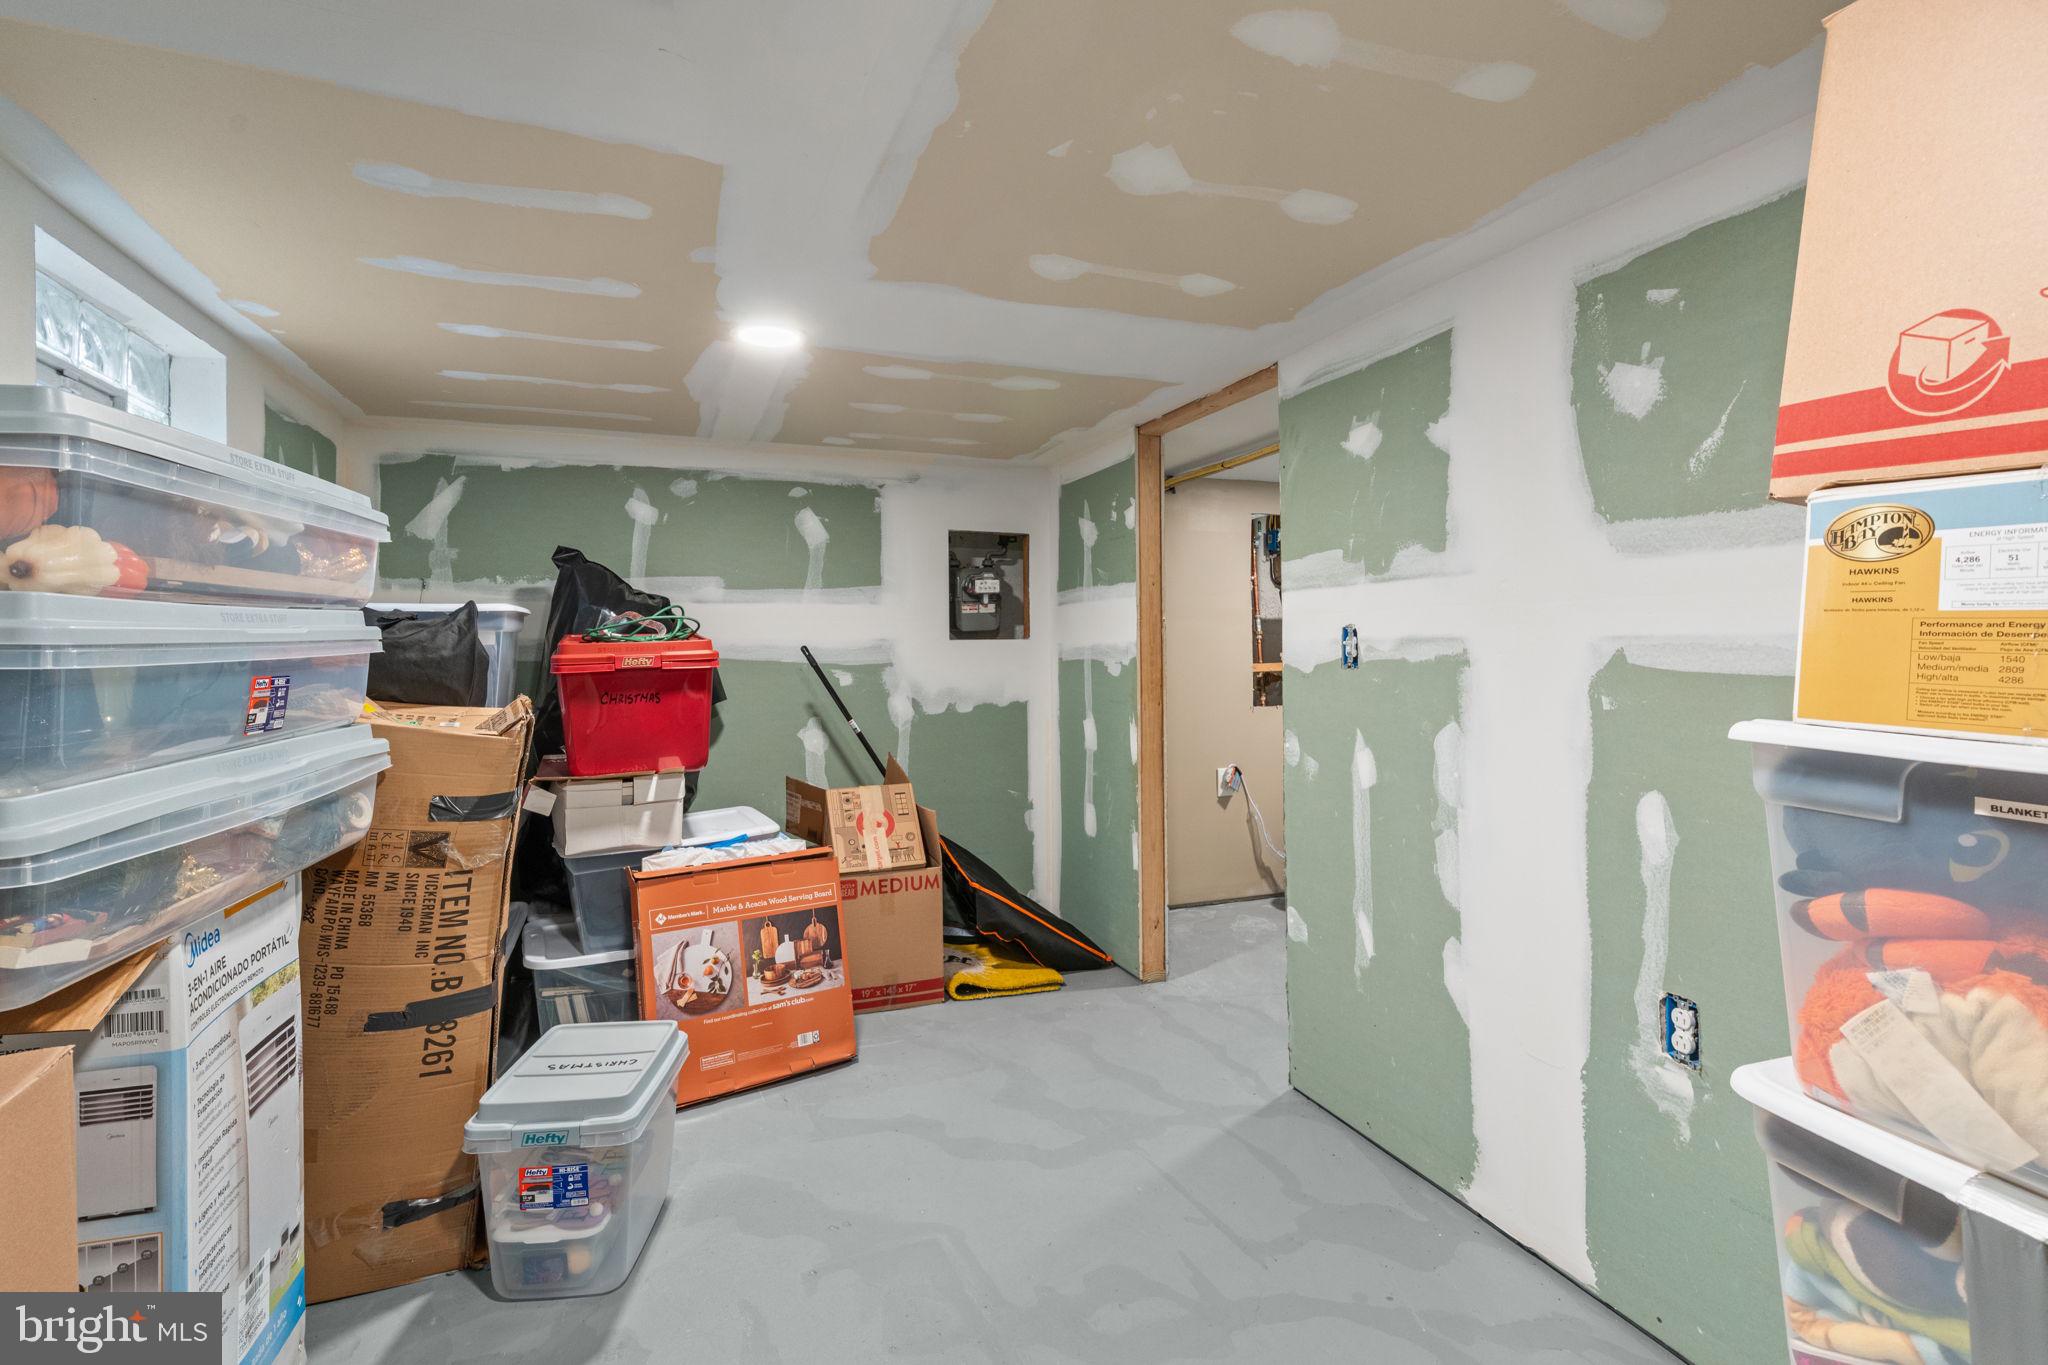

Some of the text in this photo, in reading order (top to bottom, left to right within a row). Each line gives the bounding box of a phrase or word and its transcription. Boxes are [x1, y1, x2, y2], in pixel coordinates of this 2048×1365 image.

[1832, 512, 1915, 544] HAMPTON
[1842, 526, 1878, 550] BAY
[1969, 529, 2001, 538] ENERGY
[1849, 567, 1899, 575] HAWKINS
[624, 656, 653, 667] Hefty
[1917, 654, 1961, 662] Low/baja
[1917, 663, 1989, 673] Medium/media
[1917, 673, 1959, 681] High/alta
[601, 692, 661, 704] CHRISTMAS
[384, 872, 400, 892] NYA
[861, 874, 940, 896] MEDIUM
[334, 869, 359, 950] MADE IN CHINA
[358, 871, 380, 927] MN 55368
[398, 872, 420, 932] SINCE 1940
[437, 870, 474, 929] ITEM
[712, 904, 737, 914] Marble
[745, 900, 768, 909] Acacia
[769, 895, 788, 905] Wood
[788, 893, 813, 903] Serving
[814, 889, 832, 898] Board
[414, 873, 440, 959] VICKERMAN INC
[668, 912, 690, 920] Member's
[185, 928, 220, 968] Midea
[188, 955, 227, 997] 3-EN-1 AIRE
[189, 934, 290, 1016] ACONDICIONADO PORTÁTIL
[190, 1007, 211, 1031] CONTROLES
[238, 978, 248, 989] CON
[248, 967, 264, 984] REMOTO
[324, 966, 344, 1015] PO 15488
[772, 1000, 791, 1010] sam's
[547, 1058, 638, 1071] CHRISTMAS
[525, 1133, 565, 1144] Hefty
